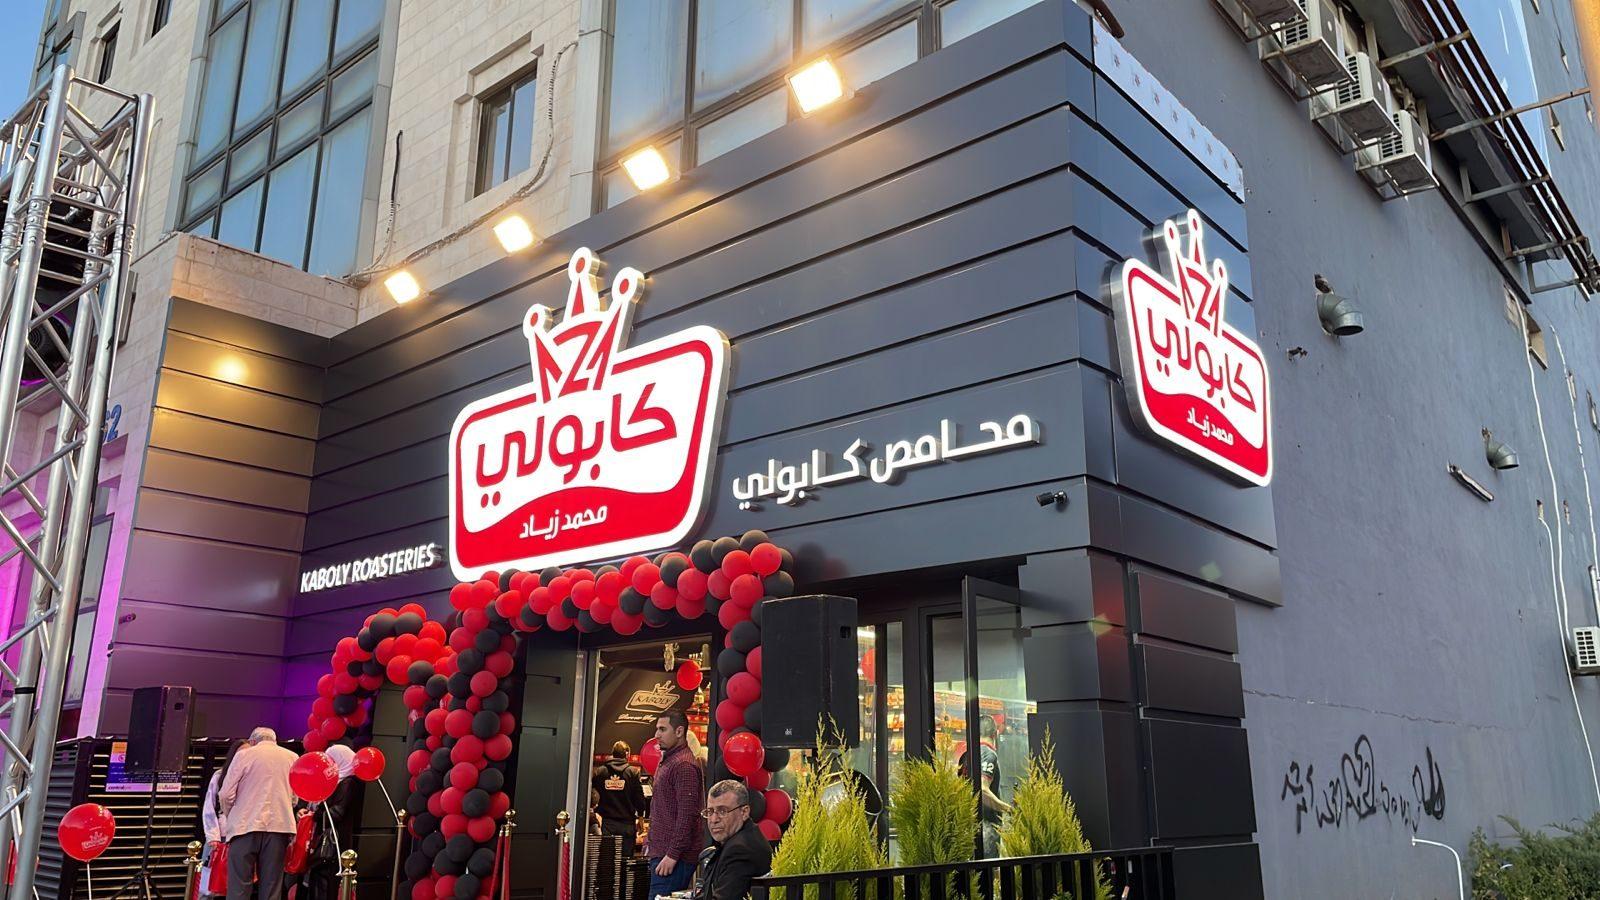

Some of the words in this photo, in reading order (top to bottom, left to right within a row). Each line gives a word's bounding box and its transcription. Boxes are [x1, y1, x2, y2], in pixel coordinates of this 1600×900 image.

[1147, 307, 1257, 413] كابولي
[476, 382, 678, 509] كابولي
[1186, 407, 1210, 438] زياد
[1210, 423, 1234, 446] محمد
[732, 438, 866, 510] كابولي
[869, 414, 1034, 484] محامص
[518, 508, 561, 541] زياد
[561, 505, 608, 531] محمد
[300, 562, 352, 593] KABOLY
[351, 542, 435, 583] ROASTERIES
